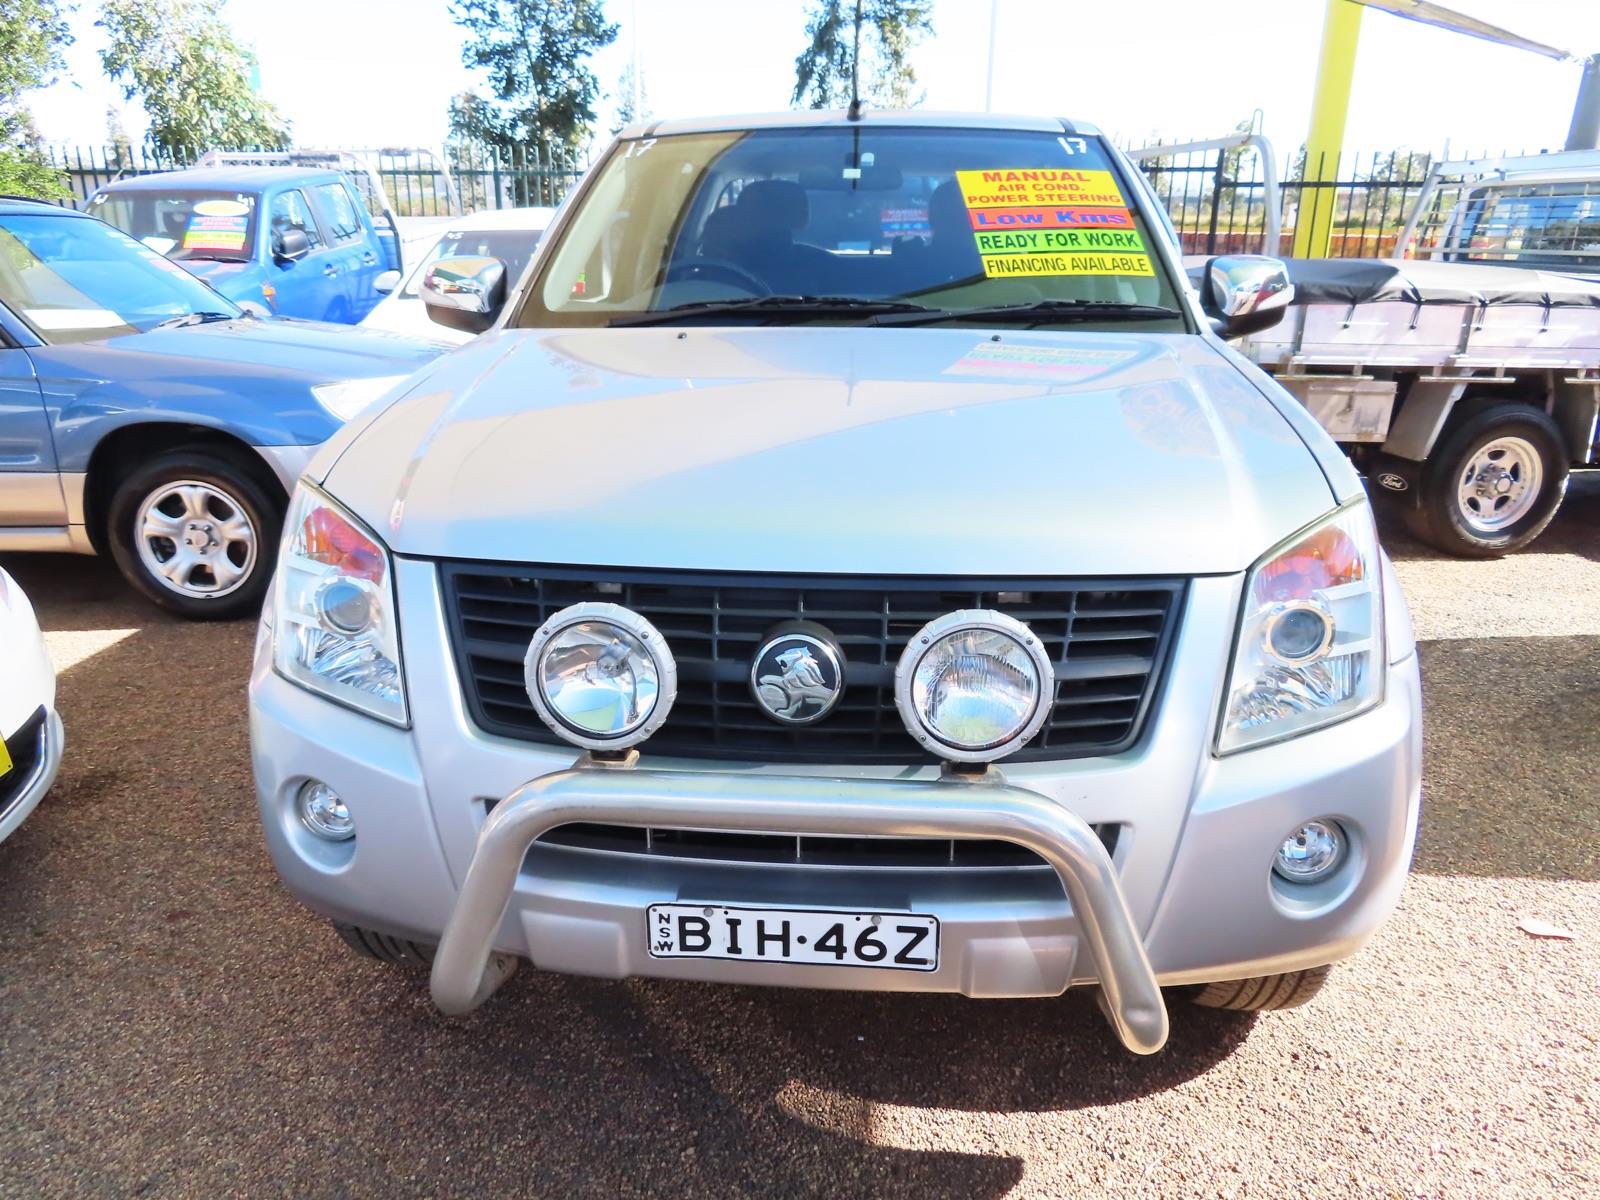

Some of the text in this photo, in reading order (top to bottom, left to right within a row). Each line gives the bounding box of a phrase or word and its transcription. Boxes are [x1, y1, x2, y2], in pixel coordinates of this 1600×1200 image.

[624, 138, 657, 158] 17
[1057, 136, 1087, 155] 17
[982, 171, 1091, 182] MANUAL
[998, 183, 1086, 192] AIR COND.
[967, 193, 1121, 204] POWER STEERING
[976, 210, 1128, 225] Low Kms
[979, 232, 1140, 250] READY FOR WORK
[986, 256, 1149, 274] FINANCING AVAILABLE
